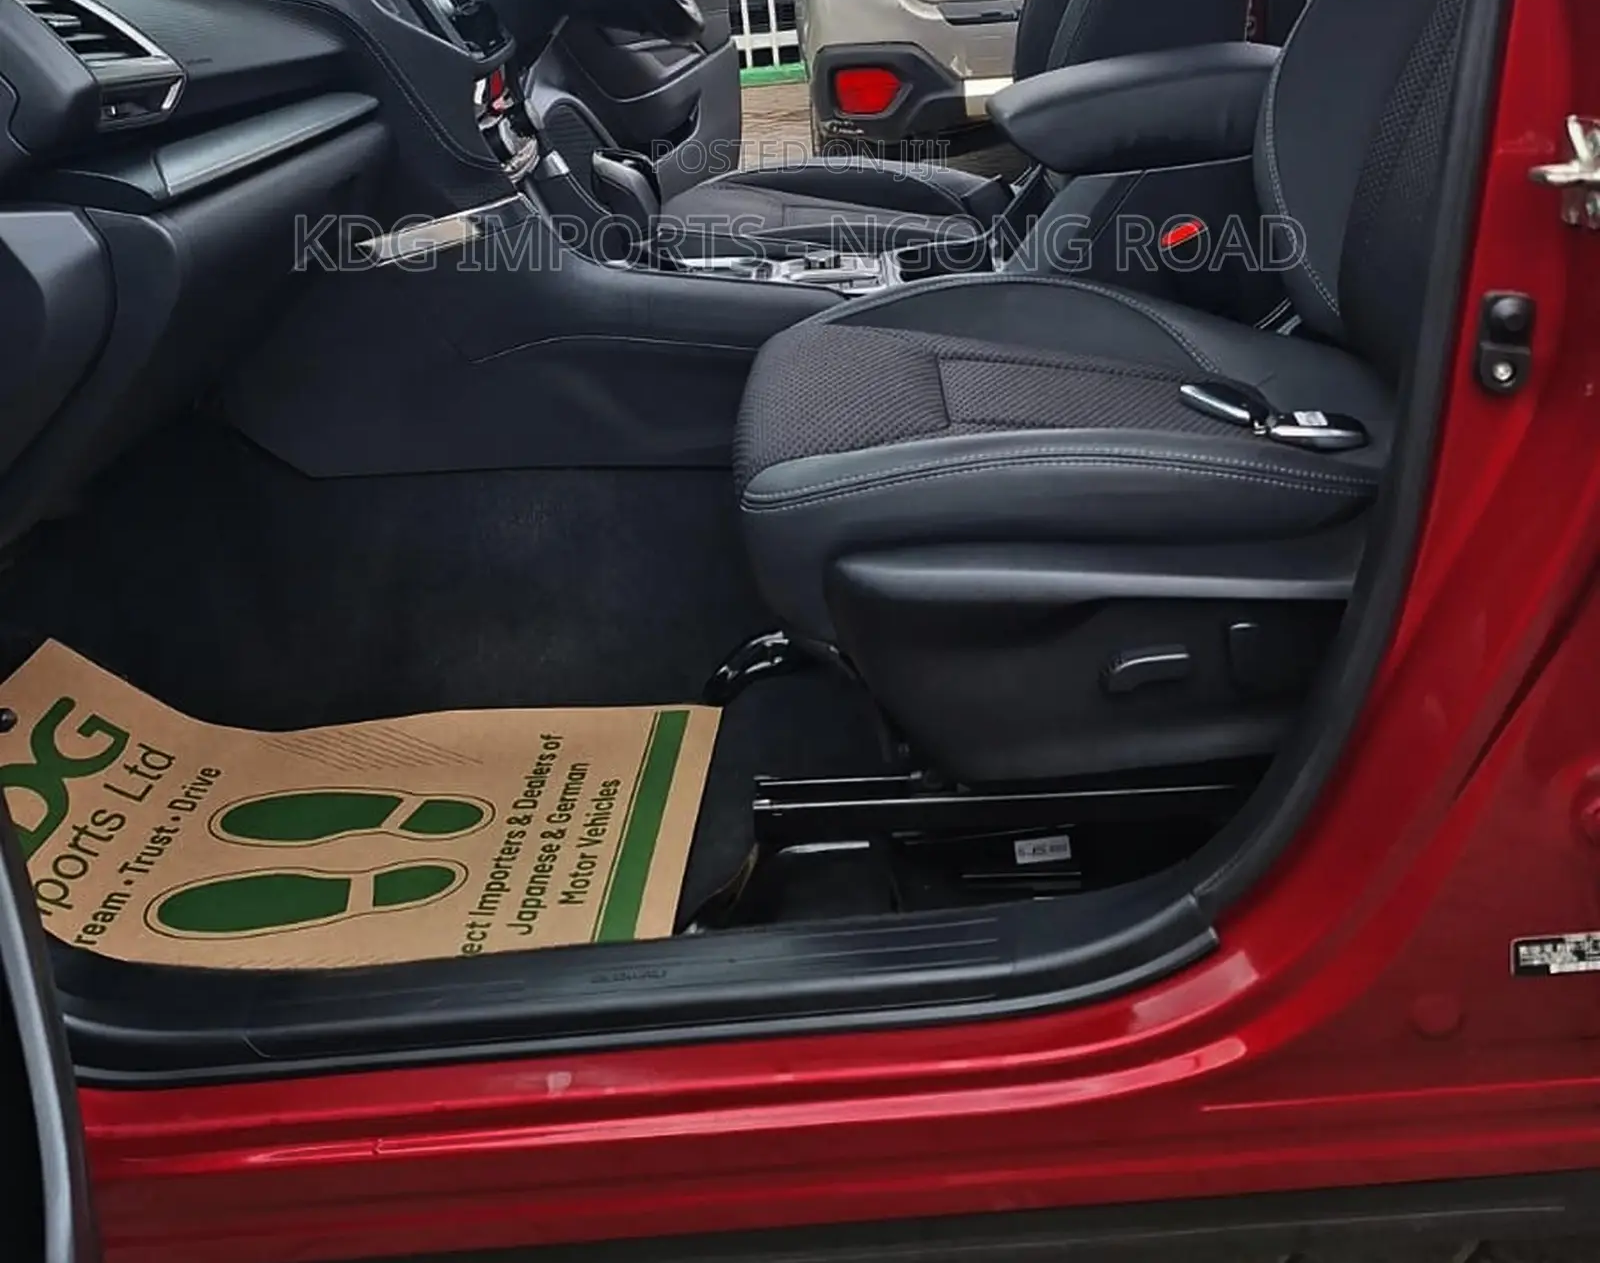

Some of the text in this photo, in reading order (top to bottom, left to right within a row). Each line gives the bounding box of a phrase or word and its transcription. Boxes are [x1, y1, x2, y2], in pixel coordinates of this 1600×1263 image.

[103, 742, 176, 803] Ltd
[539, 733, 564, 751] of
[512, 751, 557, 810] Dealers
[118, 824, 180, 876] Trust
[167, 766, 222, 812] Drive
[506, 813, 533, 828] &
[506, 762, 591, 936] Japanese & German
[558, 778, 622, 905] Motor Vehicles
[468, 830, 528, 917] Importers
